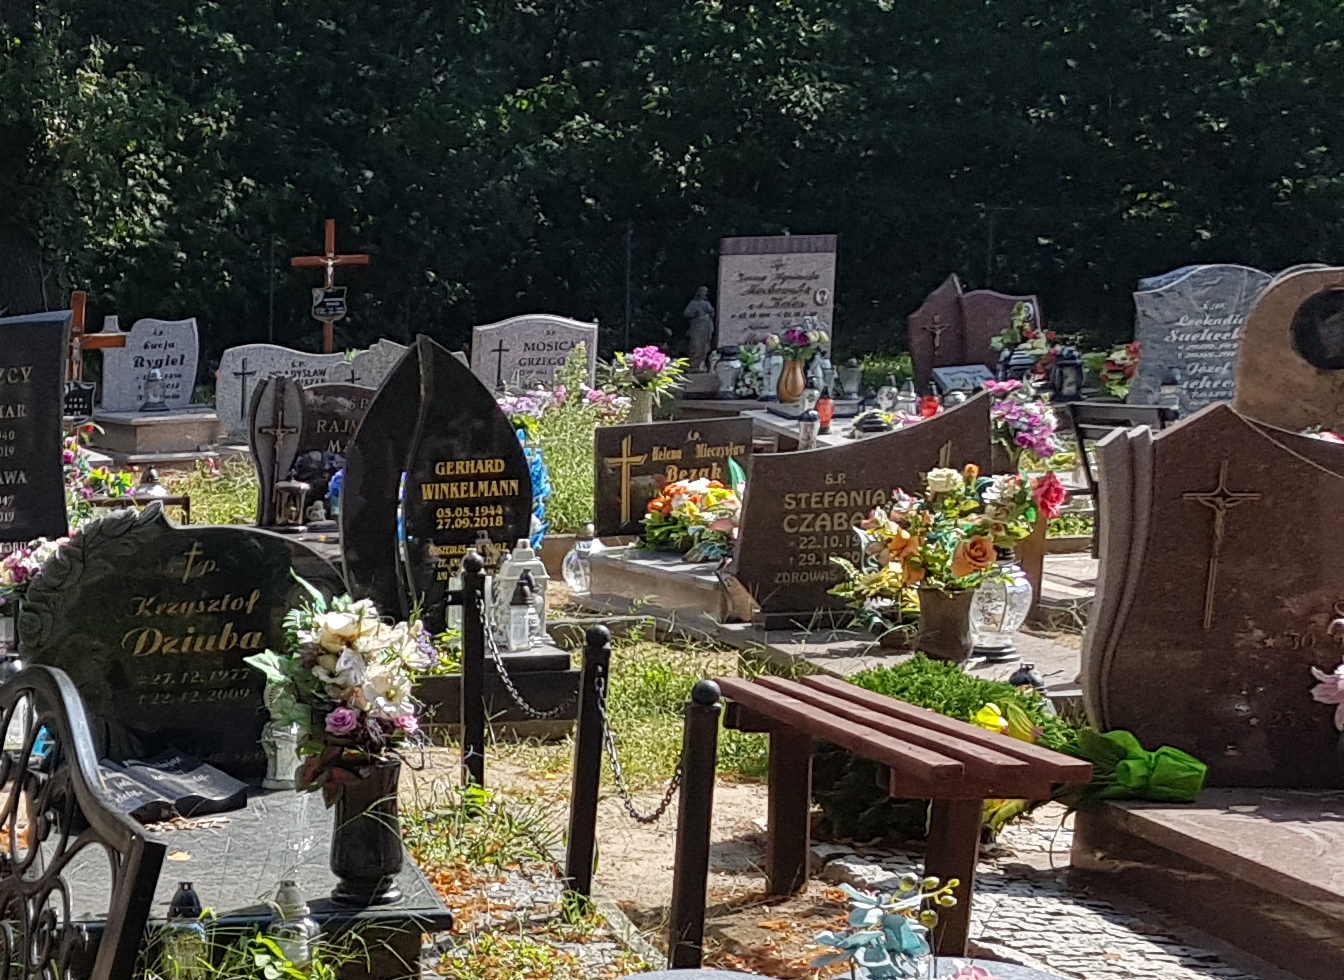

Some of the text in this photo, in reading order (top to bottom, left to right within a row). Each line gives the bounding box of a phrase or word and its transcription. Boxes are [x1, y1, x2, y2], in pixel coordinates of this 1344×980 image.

[434, 458, 506, 476] GERHARD
[420, 479, 520, 501] WINKELMANN
[783, 489, 887, 511] STEFANIA
[130, 588, 261, 618] Krzysztof
[121, 621, 268, 658] Dziuba
